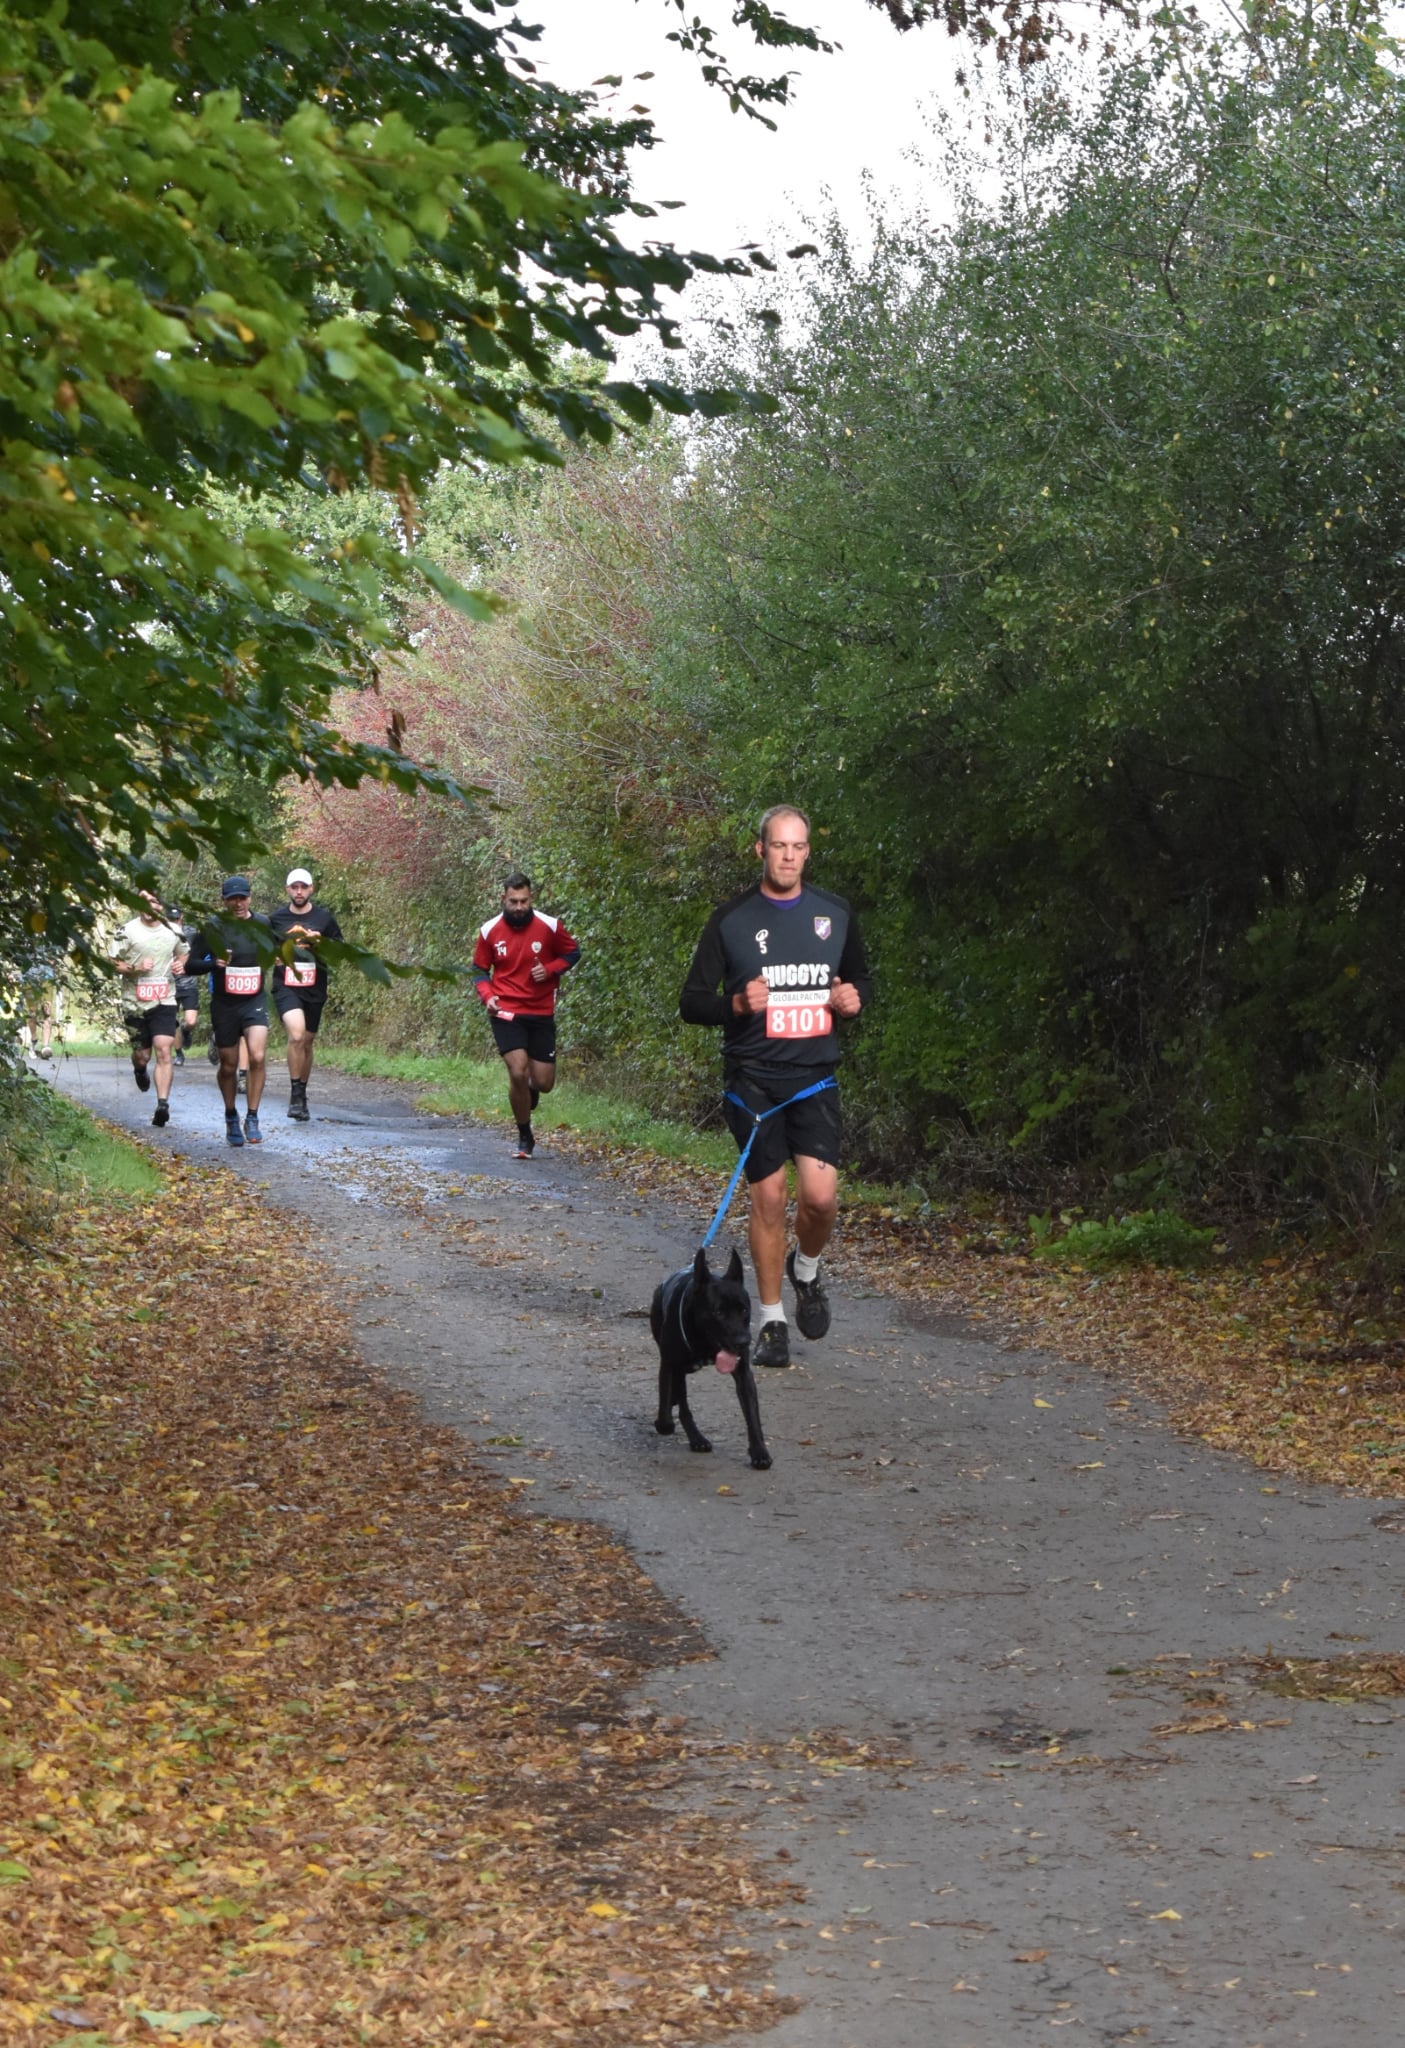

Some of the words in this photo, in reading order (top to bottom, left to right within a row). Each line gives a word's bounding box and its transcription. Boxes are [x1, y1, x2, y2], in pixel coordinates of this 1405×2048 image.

[760, 941, 767, 954] 5
[762, 963, 830, 987] HUGGYS
[228, 977, 258, 991] 8098
[139, 985, 166, 998] 8012
[772, 1008, 825, 1032] 8101
